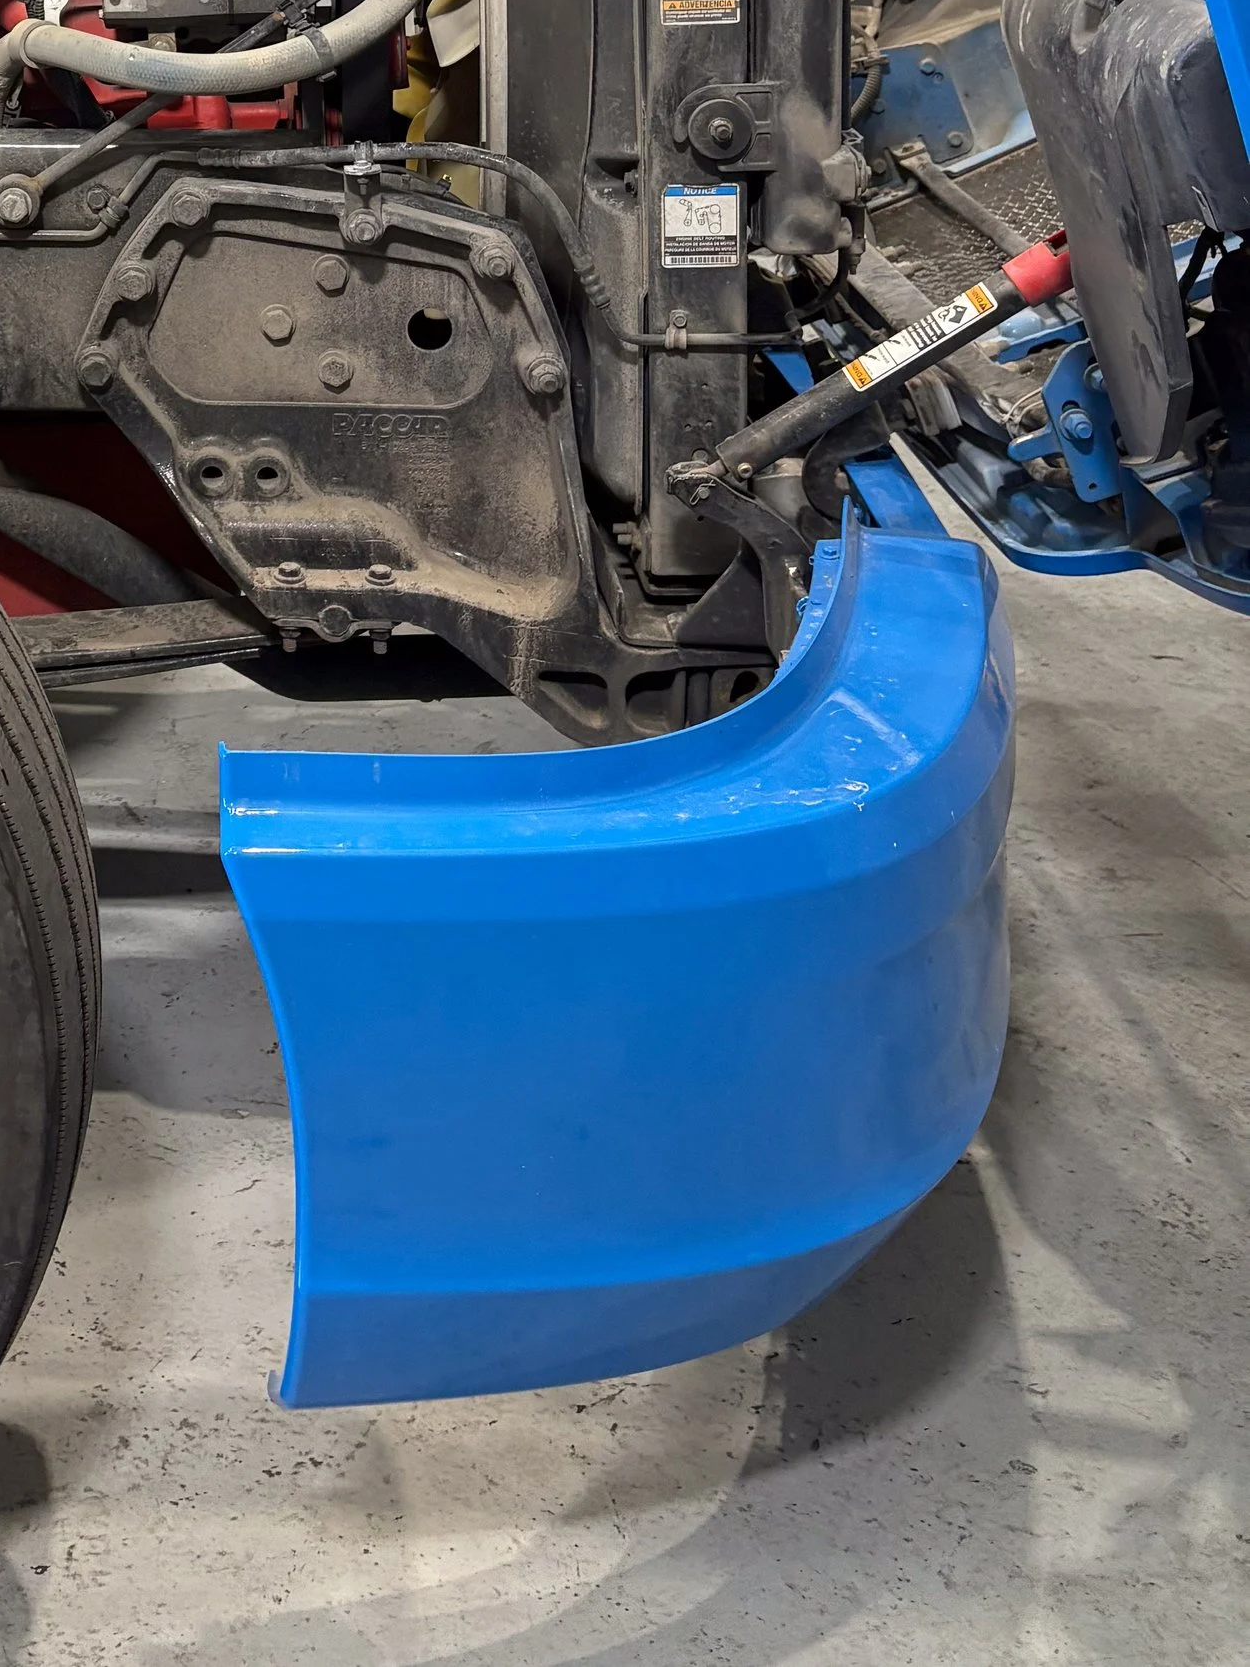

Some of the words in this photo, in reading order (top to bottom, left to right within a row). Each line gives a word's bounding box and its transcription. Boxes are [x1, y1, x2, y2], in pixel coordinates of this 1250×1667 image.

[679, 0, 733, 9] ADVERTENCIA
[683, 187, 718, 195] NOTICE
[331, 412, 451, 439] PACCAR
